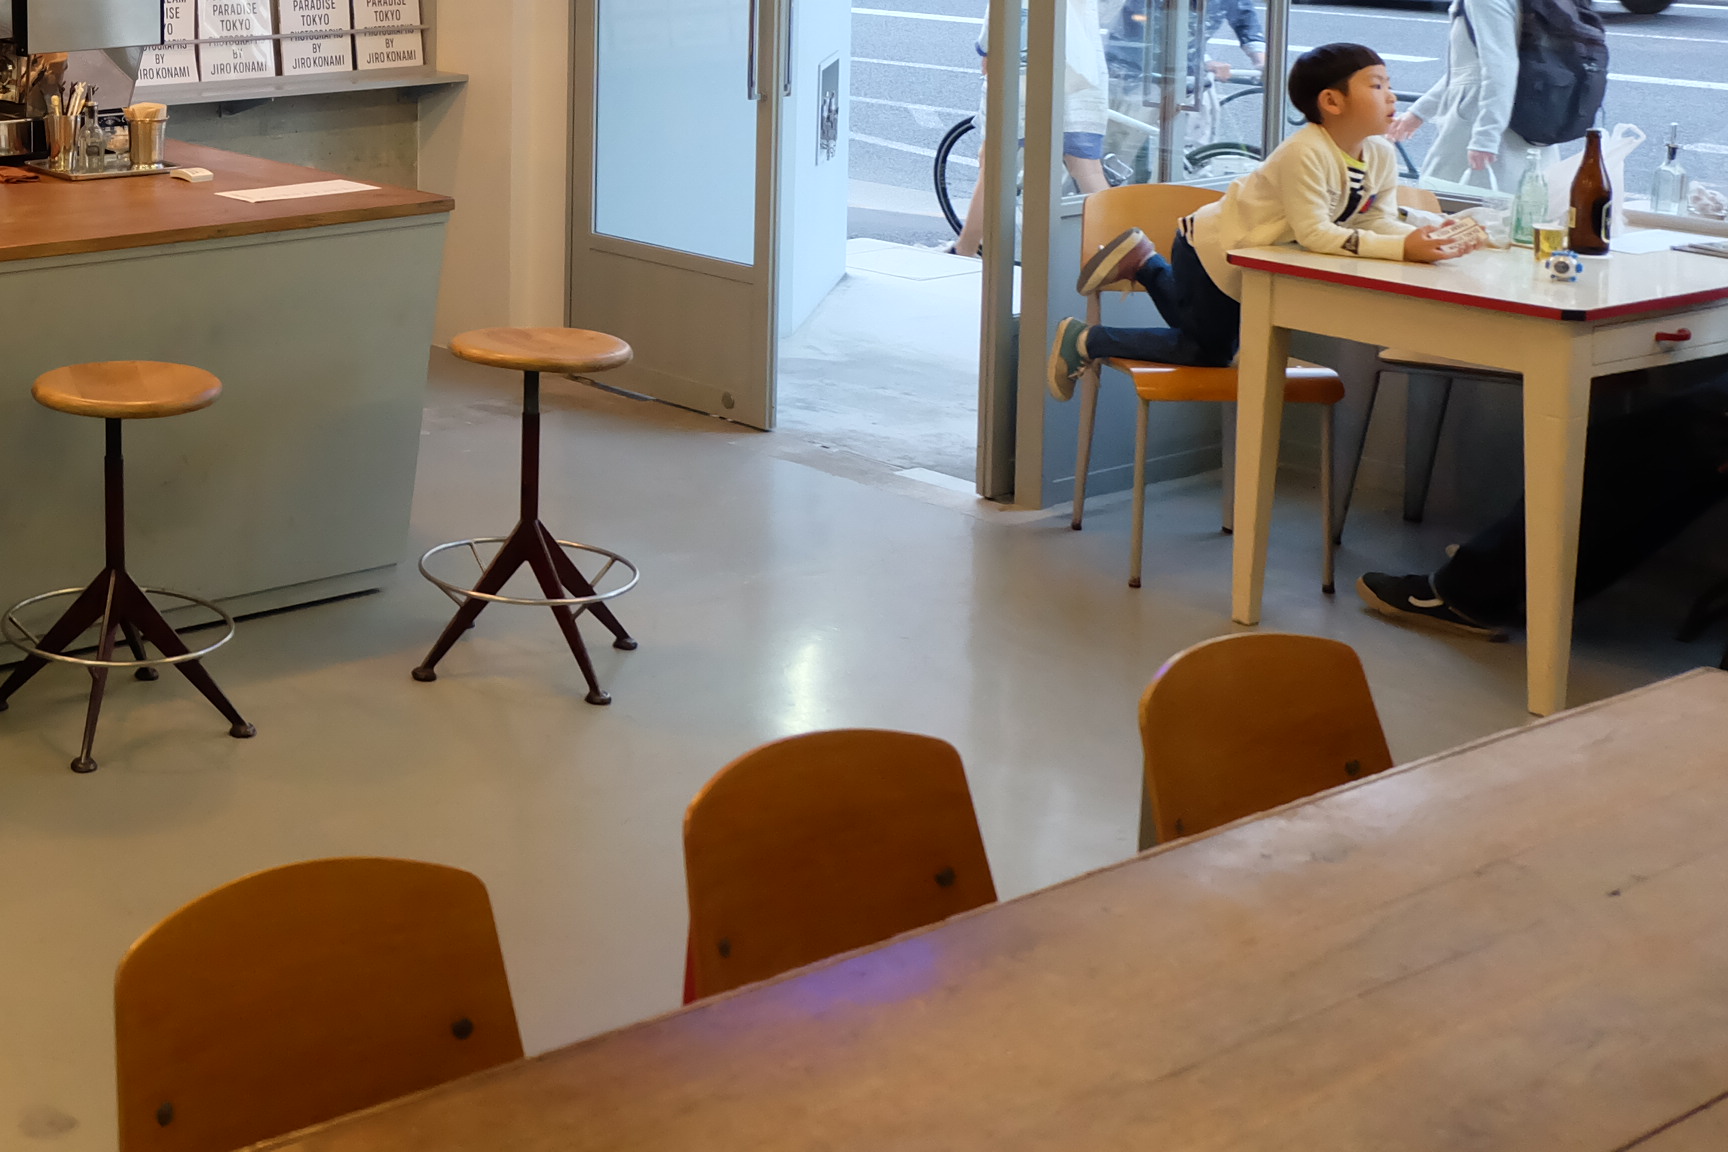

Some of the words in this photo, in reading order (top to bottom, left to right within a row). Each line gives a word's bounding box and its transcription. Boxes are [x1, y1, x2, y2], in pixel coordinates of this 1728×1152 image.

[213, 3, 257, 16] PARADISE
[301, 14, 329, 26] TOKYO
[374, 10, 400, 22] TOKYO
[220, 19, 250, 31] TOKYO
[312, 43, 321, 53] BY
[385, 38, 394, 48] BY
[155, 54, 164, 64] BY
[293, 57, 311, 69] JIRO
[313, 55, 345, 67] KONAMI
[367, 52, 384, 64] JIRO
[387, 50, 416, 62] KONAMI
[138, 68, 154, 79] IRO
[156, 66, 189, 79] KONAMI
[211, 63, 231, 75] JIRO
[233, 61, 267, 73] KONAMI
